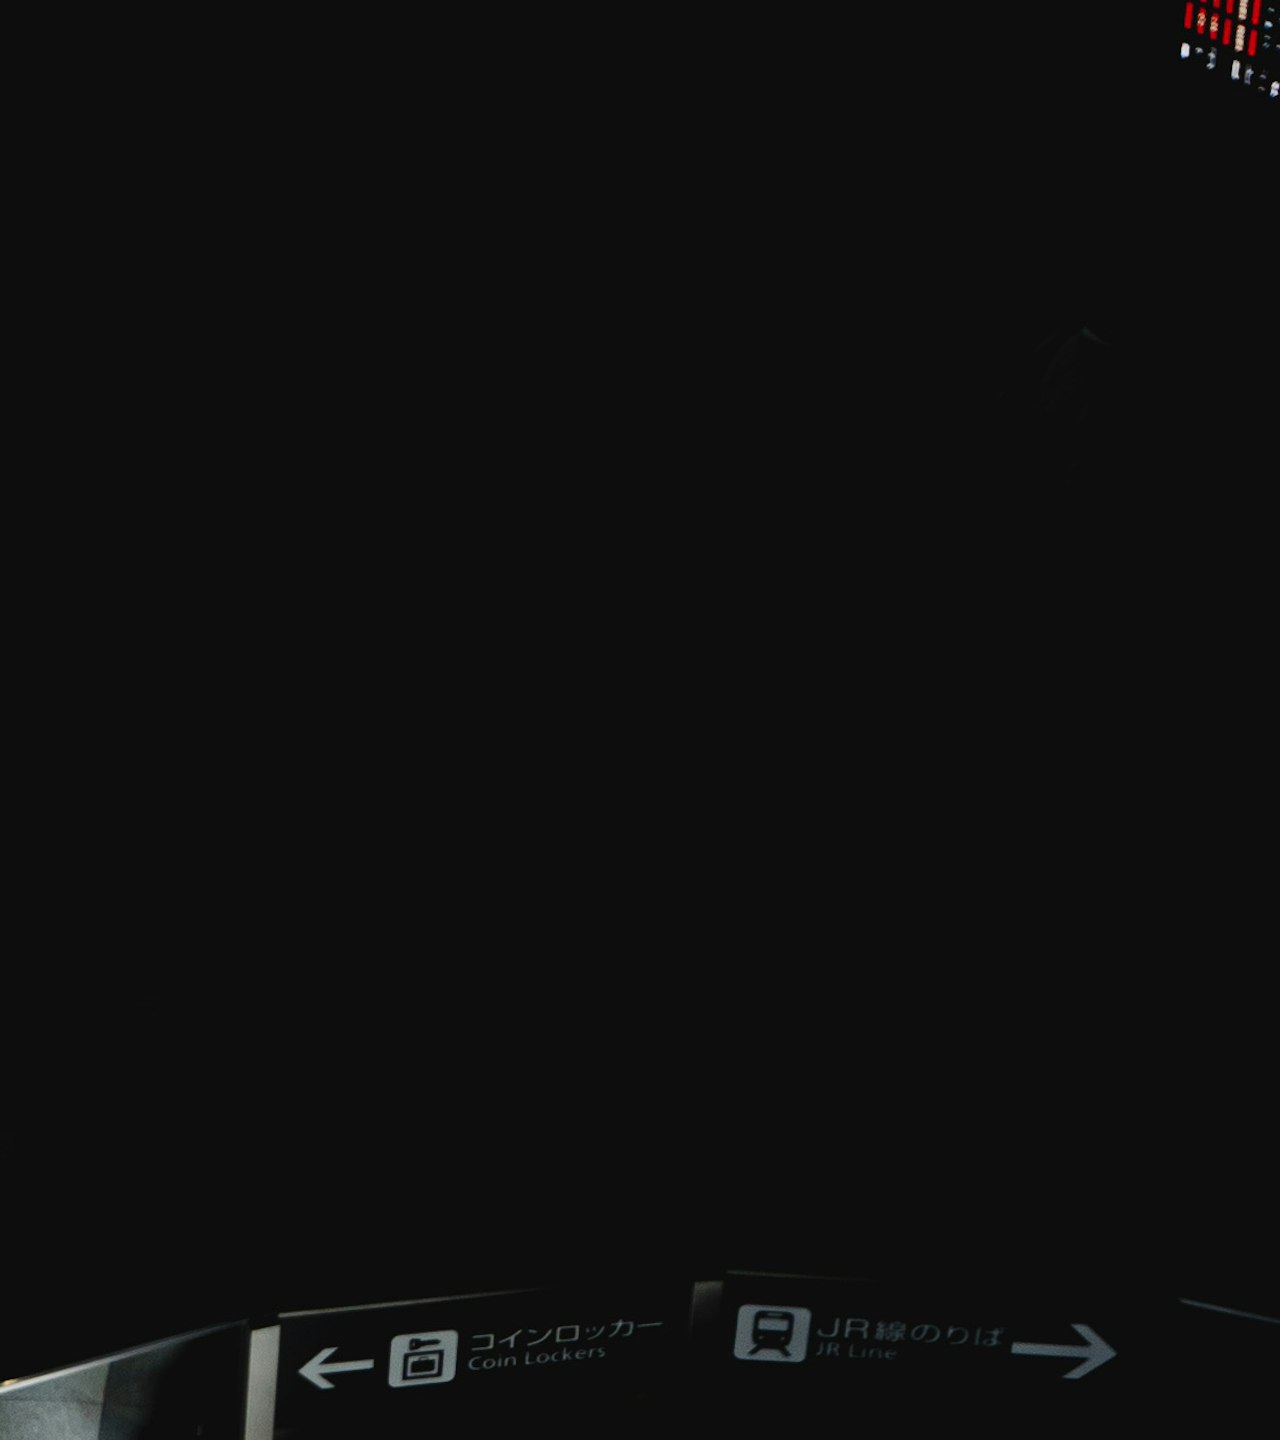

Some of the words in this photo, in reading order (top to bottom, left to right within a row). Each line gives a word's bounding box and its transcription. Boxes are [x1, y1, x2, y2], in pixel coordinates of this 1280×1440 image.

[471, 1318, 665, 1351] コインロッカー
[815, 1317, 1006, 1347] JR線のりば
[467, 1354, 517, 1371] Coin
[524, 1345, 607, 1366] Lockers
[815, 1341, 841, 1357] JR
[847, 1343, 899, 1360] Line
